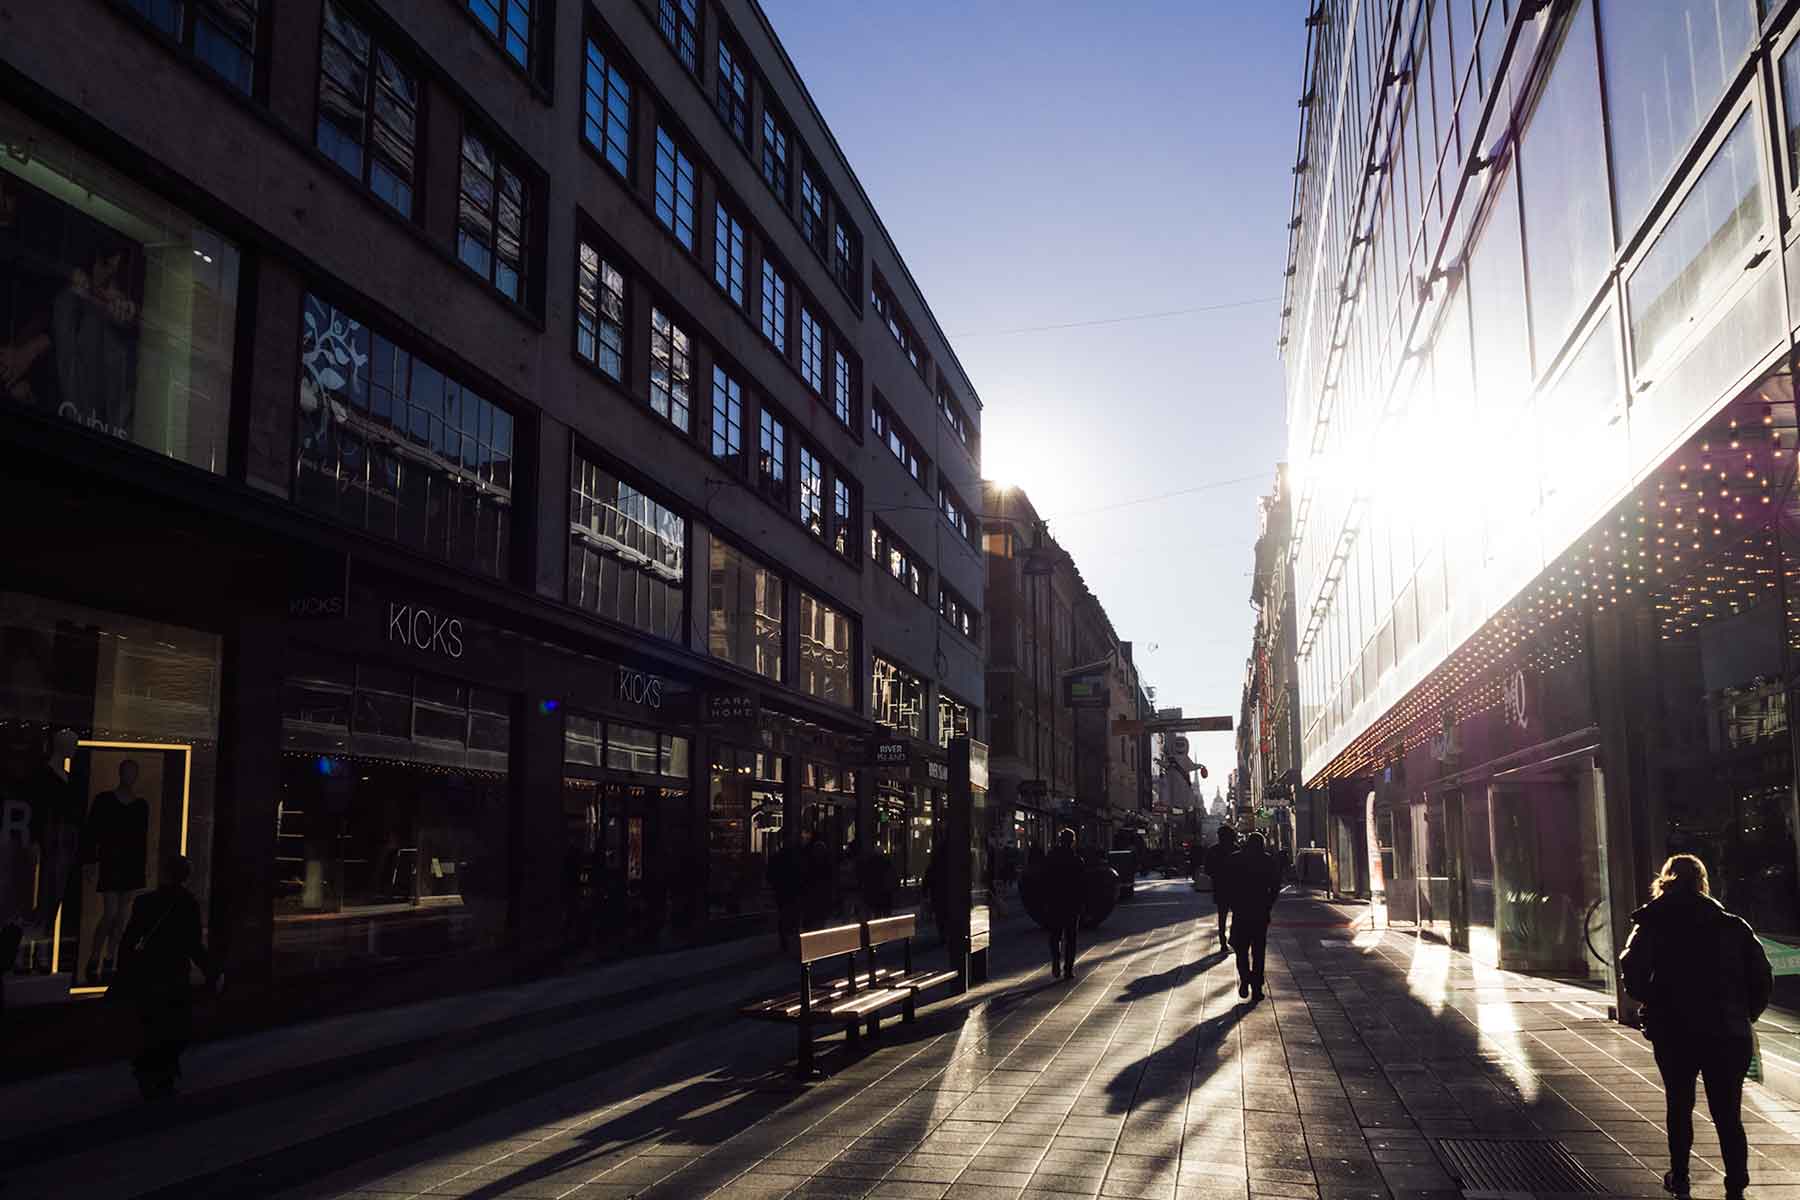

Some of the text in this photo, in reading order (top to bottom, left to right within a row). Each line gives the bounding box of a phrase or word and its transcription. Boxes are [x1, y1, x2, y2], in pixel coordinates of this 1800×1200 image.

[289, 597, 344, 616] KICKS
[389, 602, 463, 658] KICKS
[619, 671, 662, 709] KICKS
[711, 696, 752, 706] ZARA
[711, 708, 752, 718] HOME
[879, 744, 903, 753] RIVER
